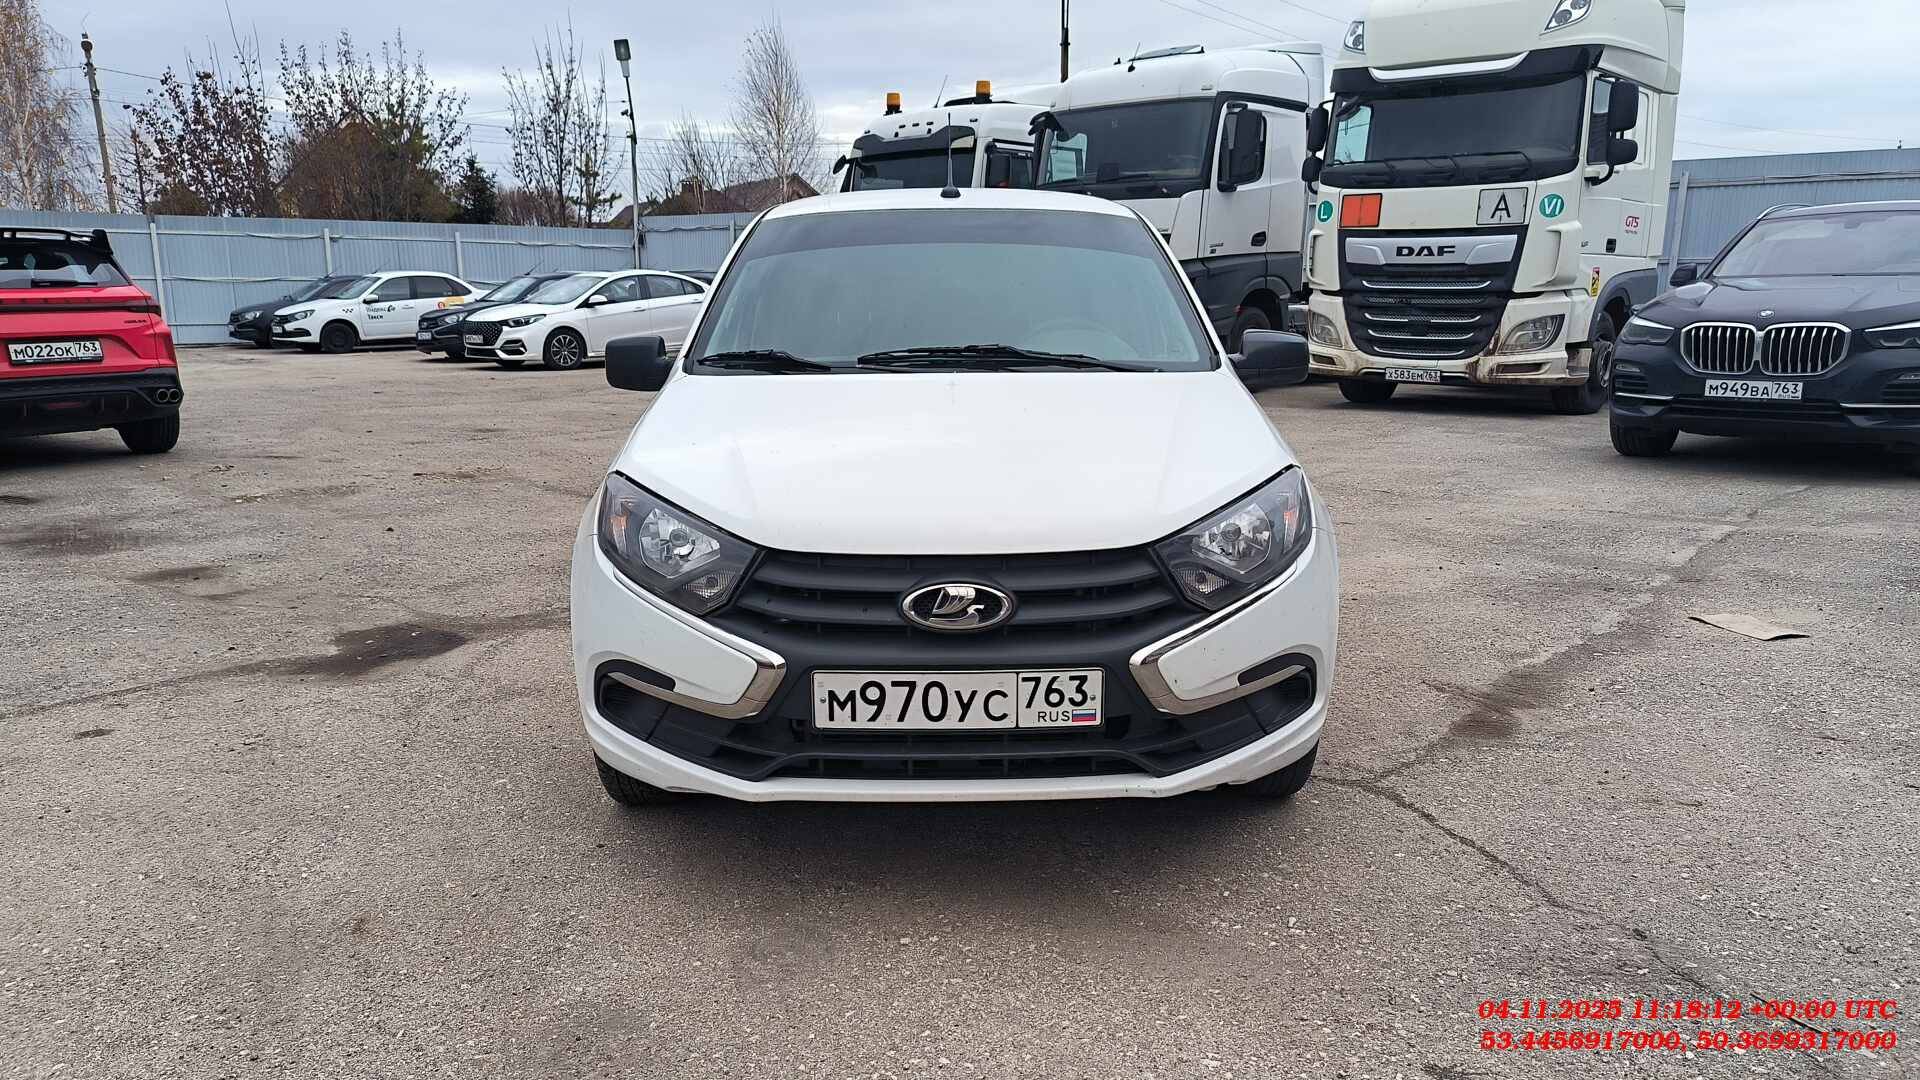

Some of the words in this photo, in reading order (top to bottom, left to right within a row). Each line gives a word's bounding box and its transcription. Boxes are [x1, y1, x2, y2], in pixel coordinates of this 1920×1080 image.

[1320, 204, 1328, 219] L
[1489, 191, 1511, 219] A
[1543, 197, 1562, 215] VI
[1625, 215, 1640, 228] GTS
[1395, 245, 1456, 257] DAF
[13, 344, 75, 359] М022ОК
[75, 342, 98, 353] 763
[1424, 371, 1439, 379] 763
[1708, 381, 1770, 397] М949ВА
[1774, 382, 1799, 394] 763
[827, 680, 1009, 723] М970УС
[1021, 674, 1089, 709] 763
[1037, 710, 1071, 722] RUS
